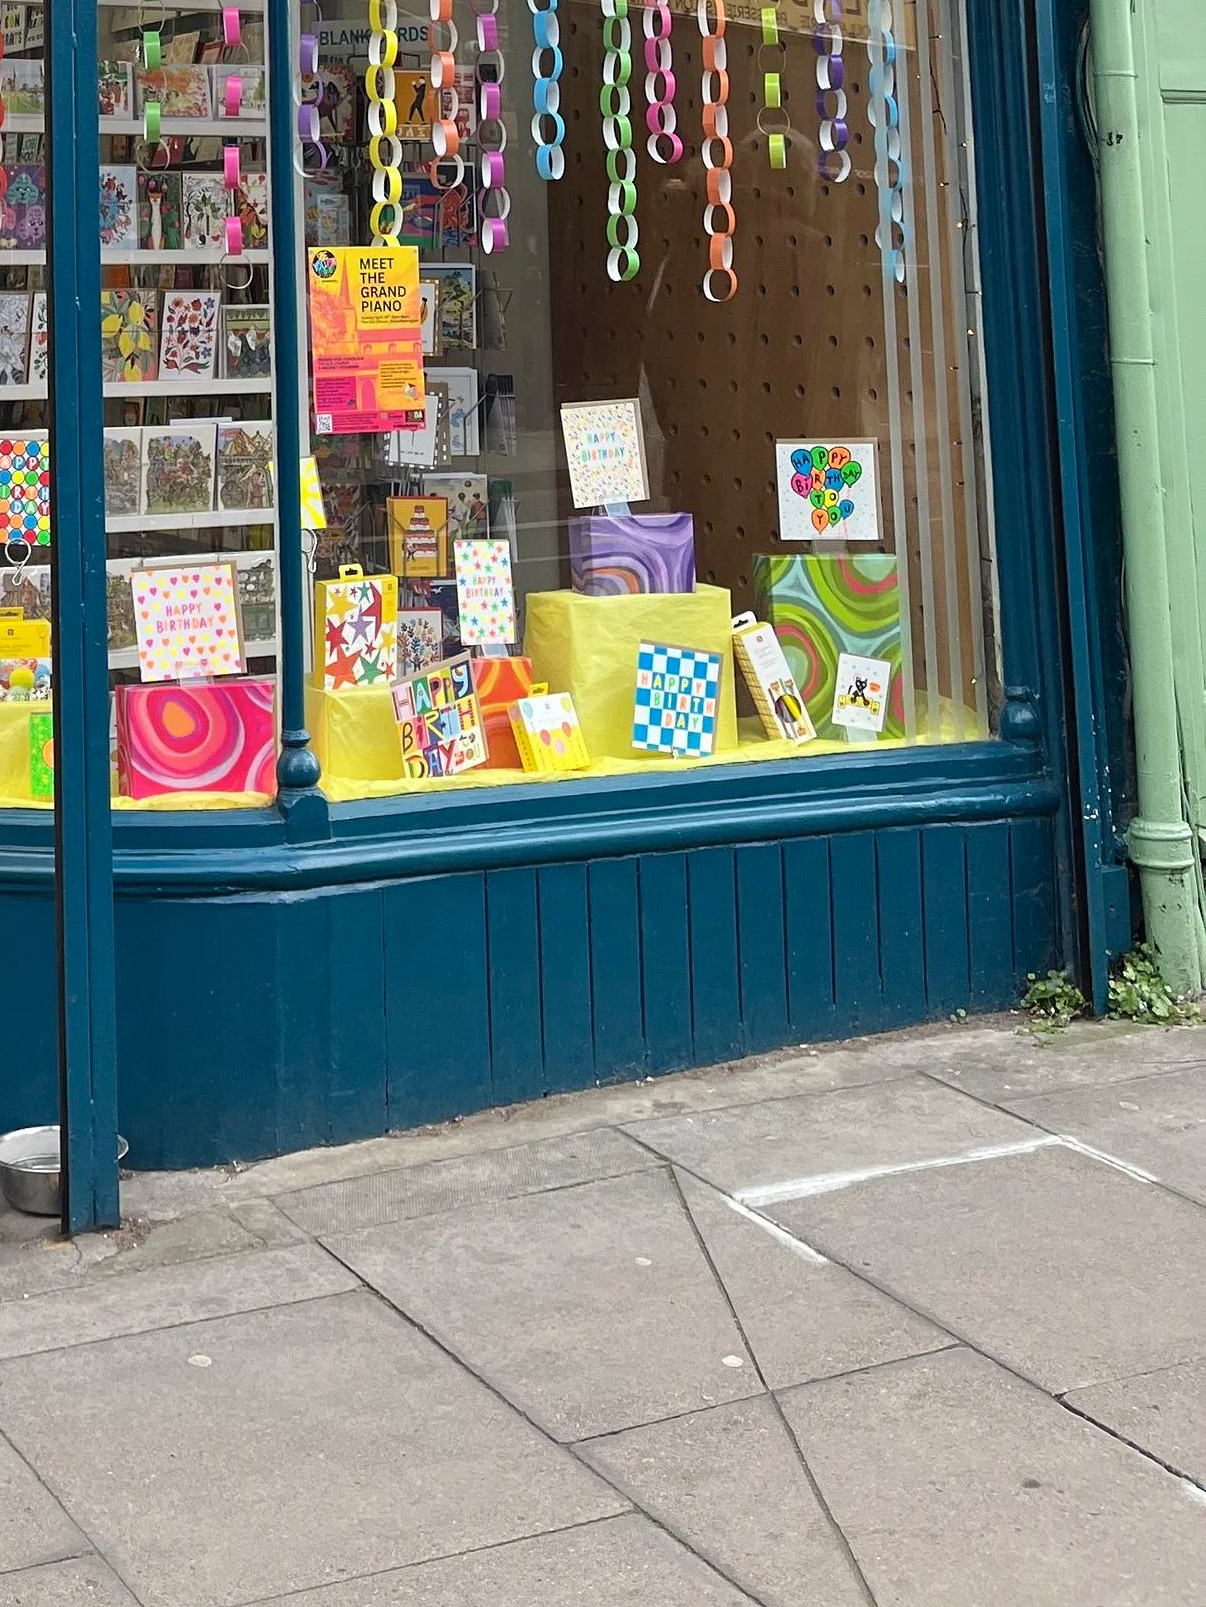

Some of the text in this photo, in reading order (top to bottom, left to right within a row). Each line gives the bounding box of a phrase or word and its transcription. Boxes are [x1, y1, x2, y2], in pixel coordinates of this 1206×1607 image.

[359, 257, 395, 270] MEET
[360, 271, 386, 284] THE
[360, 285, 406, 298] GRAND
[361, 300, 402, 312] PIANO
[586, 432, 616, 443] HAPPY
[581, 447, 625, 462] BIRTHDAY
[793, 451, 847, 468] HAPPY
[814, 492, 836, 504] TO
[14, 500, 50, 516] DAY
[816, 506, 851, 525] YOU
[472, 575, 496, 586] HAPPY
[465, 587, 504, 599] BIRTHDAY
[165, 602, 202, 617] HAPPY
[156, 615, 213, 634] BIRTHDAY
[641, 672, 702, 695] HAPPY
[654, 692, 714, 715] BIRTH
[665, 713, 699, 730] DAY
